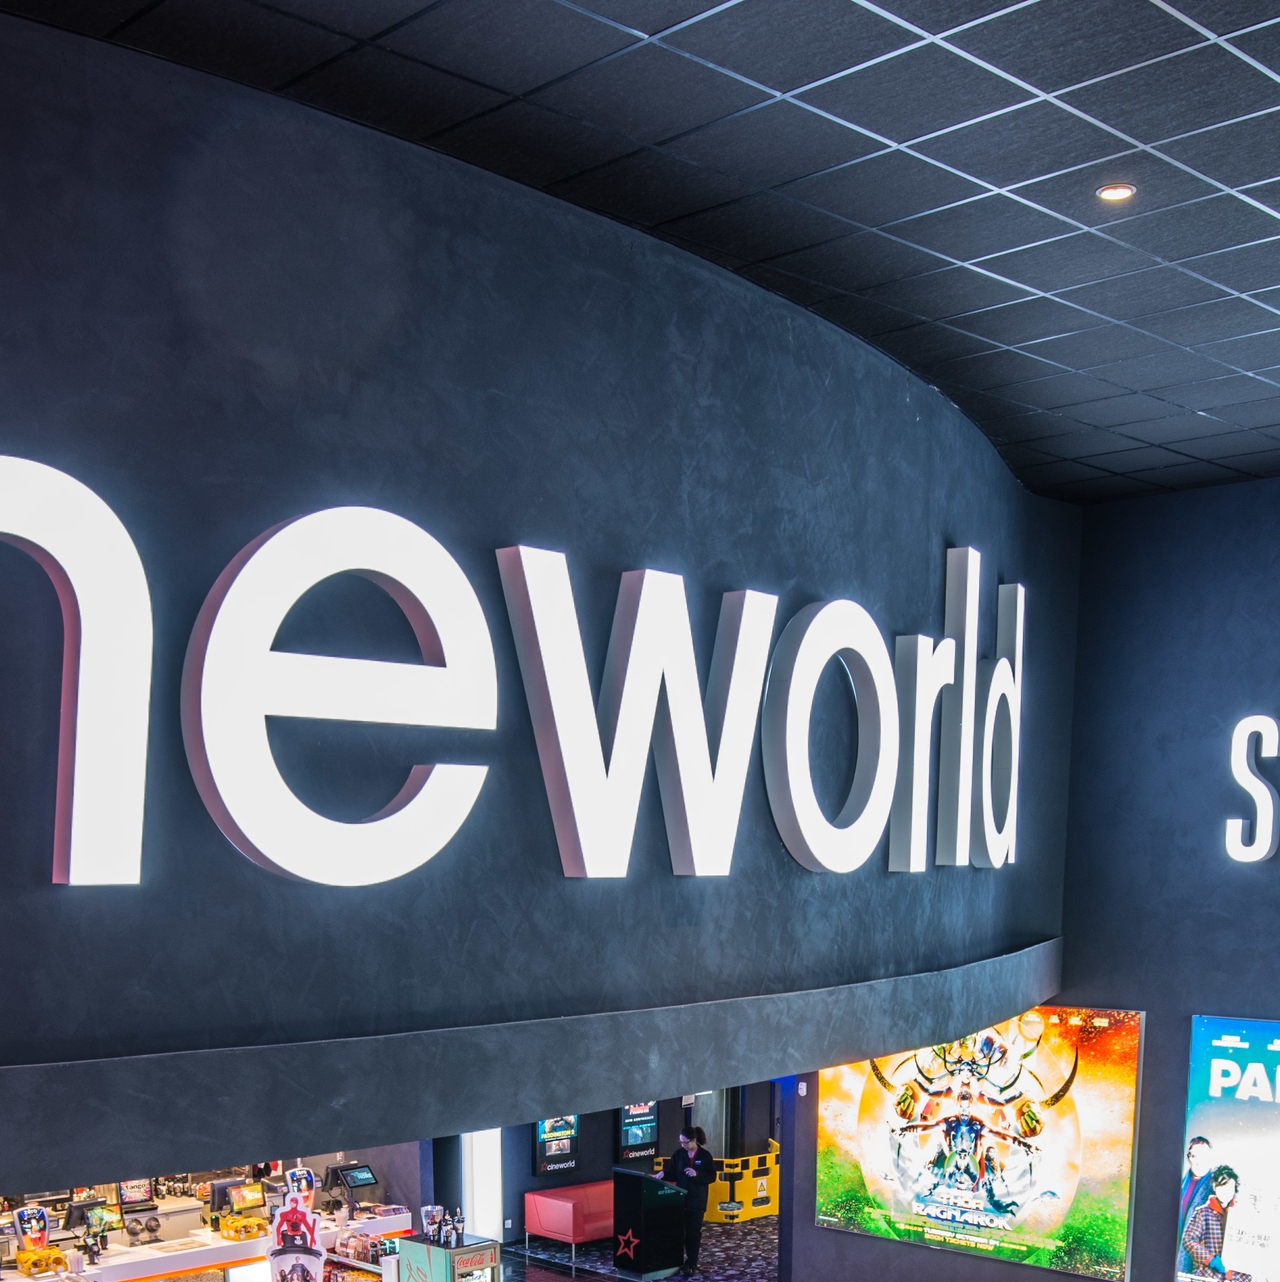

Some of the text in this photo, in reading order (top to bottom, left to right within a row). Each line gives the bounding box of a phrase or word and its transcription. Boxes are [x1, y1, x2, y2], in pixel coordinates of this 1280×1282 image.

[628, 1148, 656, 1158] cineworld
[547, 1160, 576, 1171] cineworld
[911, 1200, 1013, 1231] RAGNAROK
[456, 1252, 486, 1269] Coca-Cola
